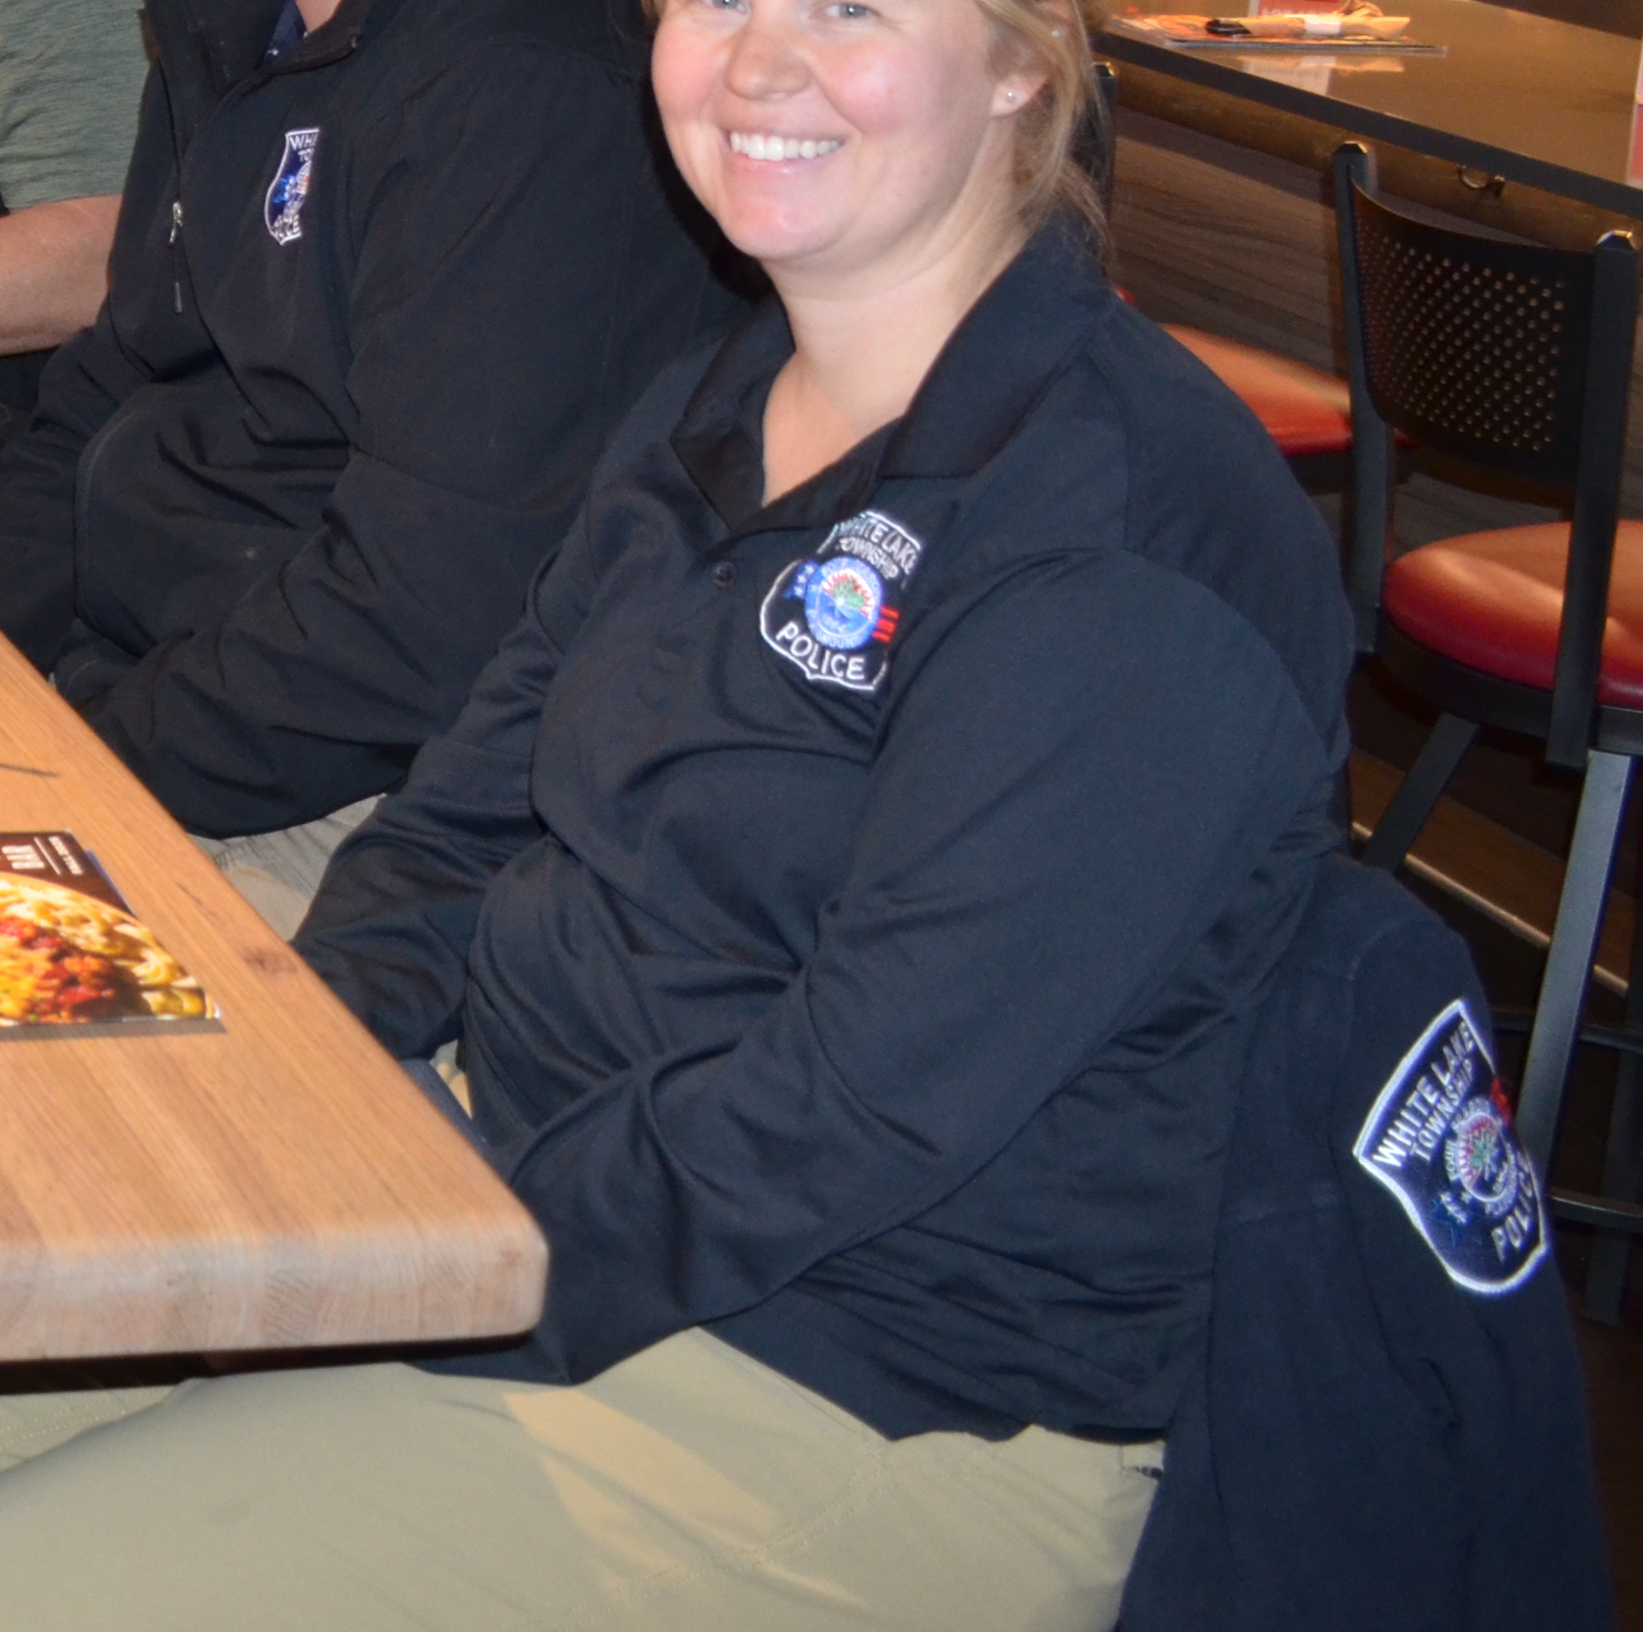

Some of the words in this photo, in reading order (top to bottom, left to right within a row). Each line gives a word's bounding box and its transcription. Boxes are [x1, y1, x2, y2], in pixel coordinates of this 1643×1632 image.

[776, 621, 866, 681] POLICE
[1373, 1075, 1442, 1167] WHITE
[1431, 1022, 1478, 1086] LAKE
[1410, 1060, 1474, 1162] TOWNSHIP
